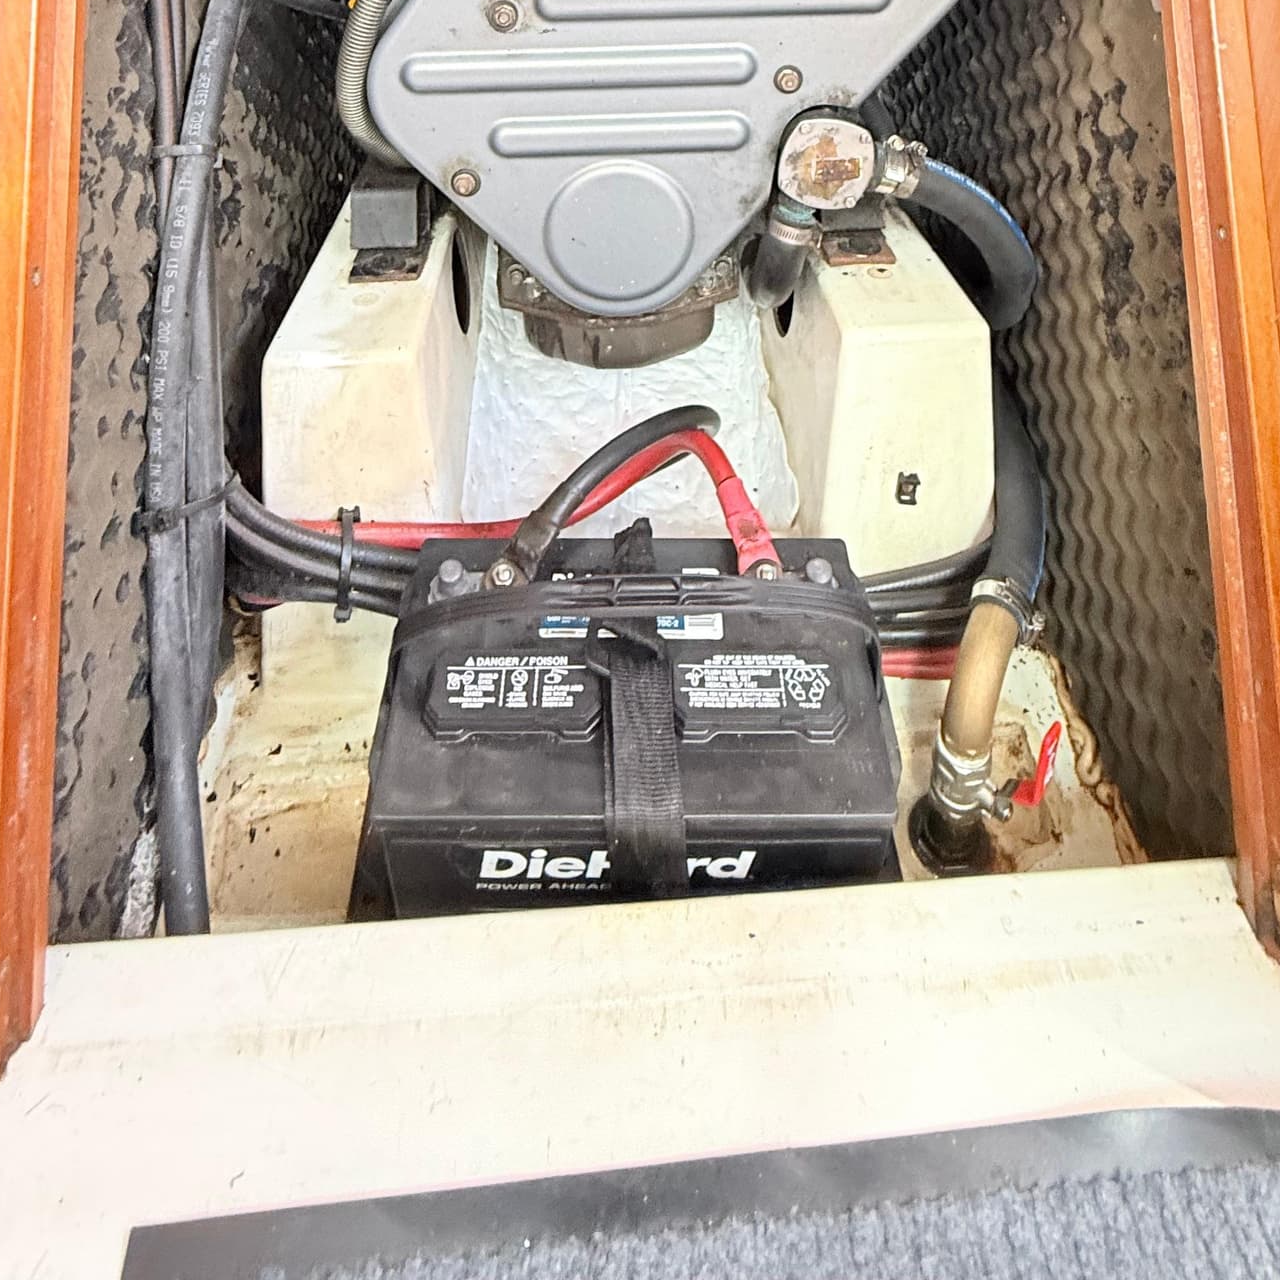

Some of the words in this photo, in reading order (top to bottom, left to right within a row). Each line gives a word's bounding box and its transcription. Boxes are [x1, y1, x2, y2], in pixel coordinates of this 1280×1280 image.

[194, 72, 212, 106] SERIES
[189, 111, 206, 136] 7093
[173, 205, 189, 228] 5/8
[170, 235, 183, 249] ID
[157, 321, 171, 343] 200
[155, 350, 169, 370] PSI
[153, 378, 166, 400] MAX
[150, 428, 163, 456] MADE
[149, 463, 162, 477] IN
[149, 482, 162, 504] USA
[476, 657, 519, 666] DANGER
[529, 656, 568, 666] POISON
[480, 848, 757, 880] DieHrd
[476, 882, 541, 890] POWER
